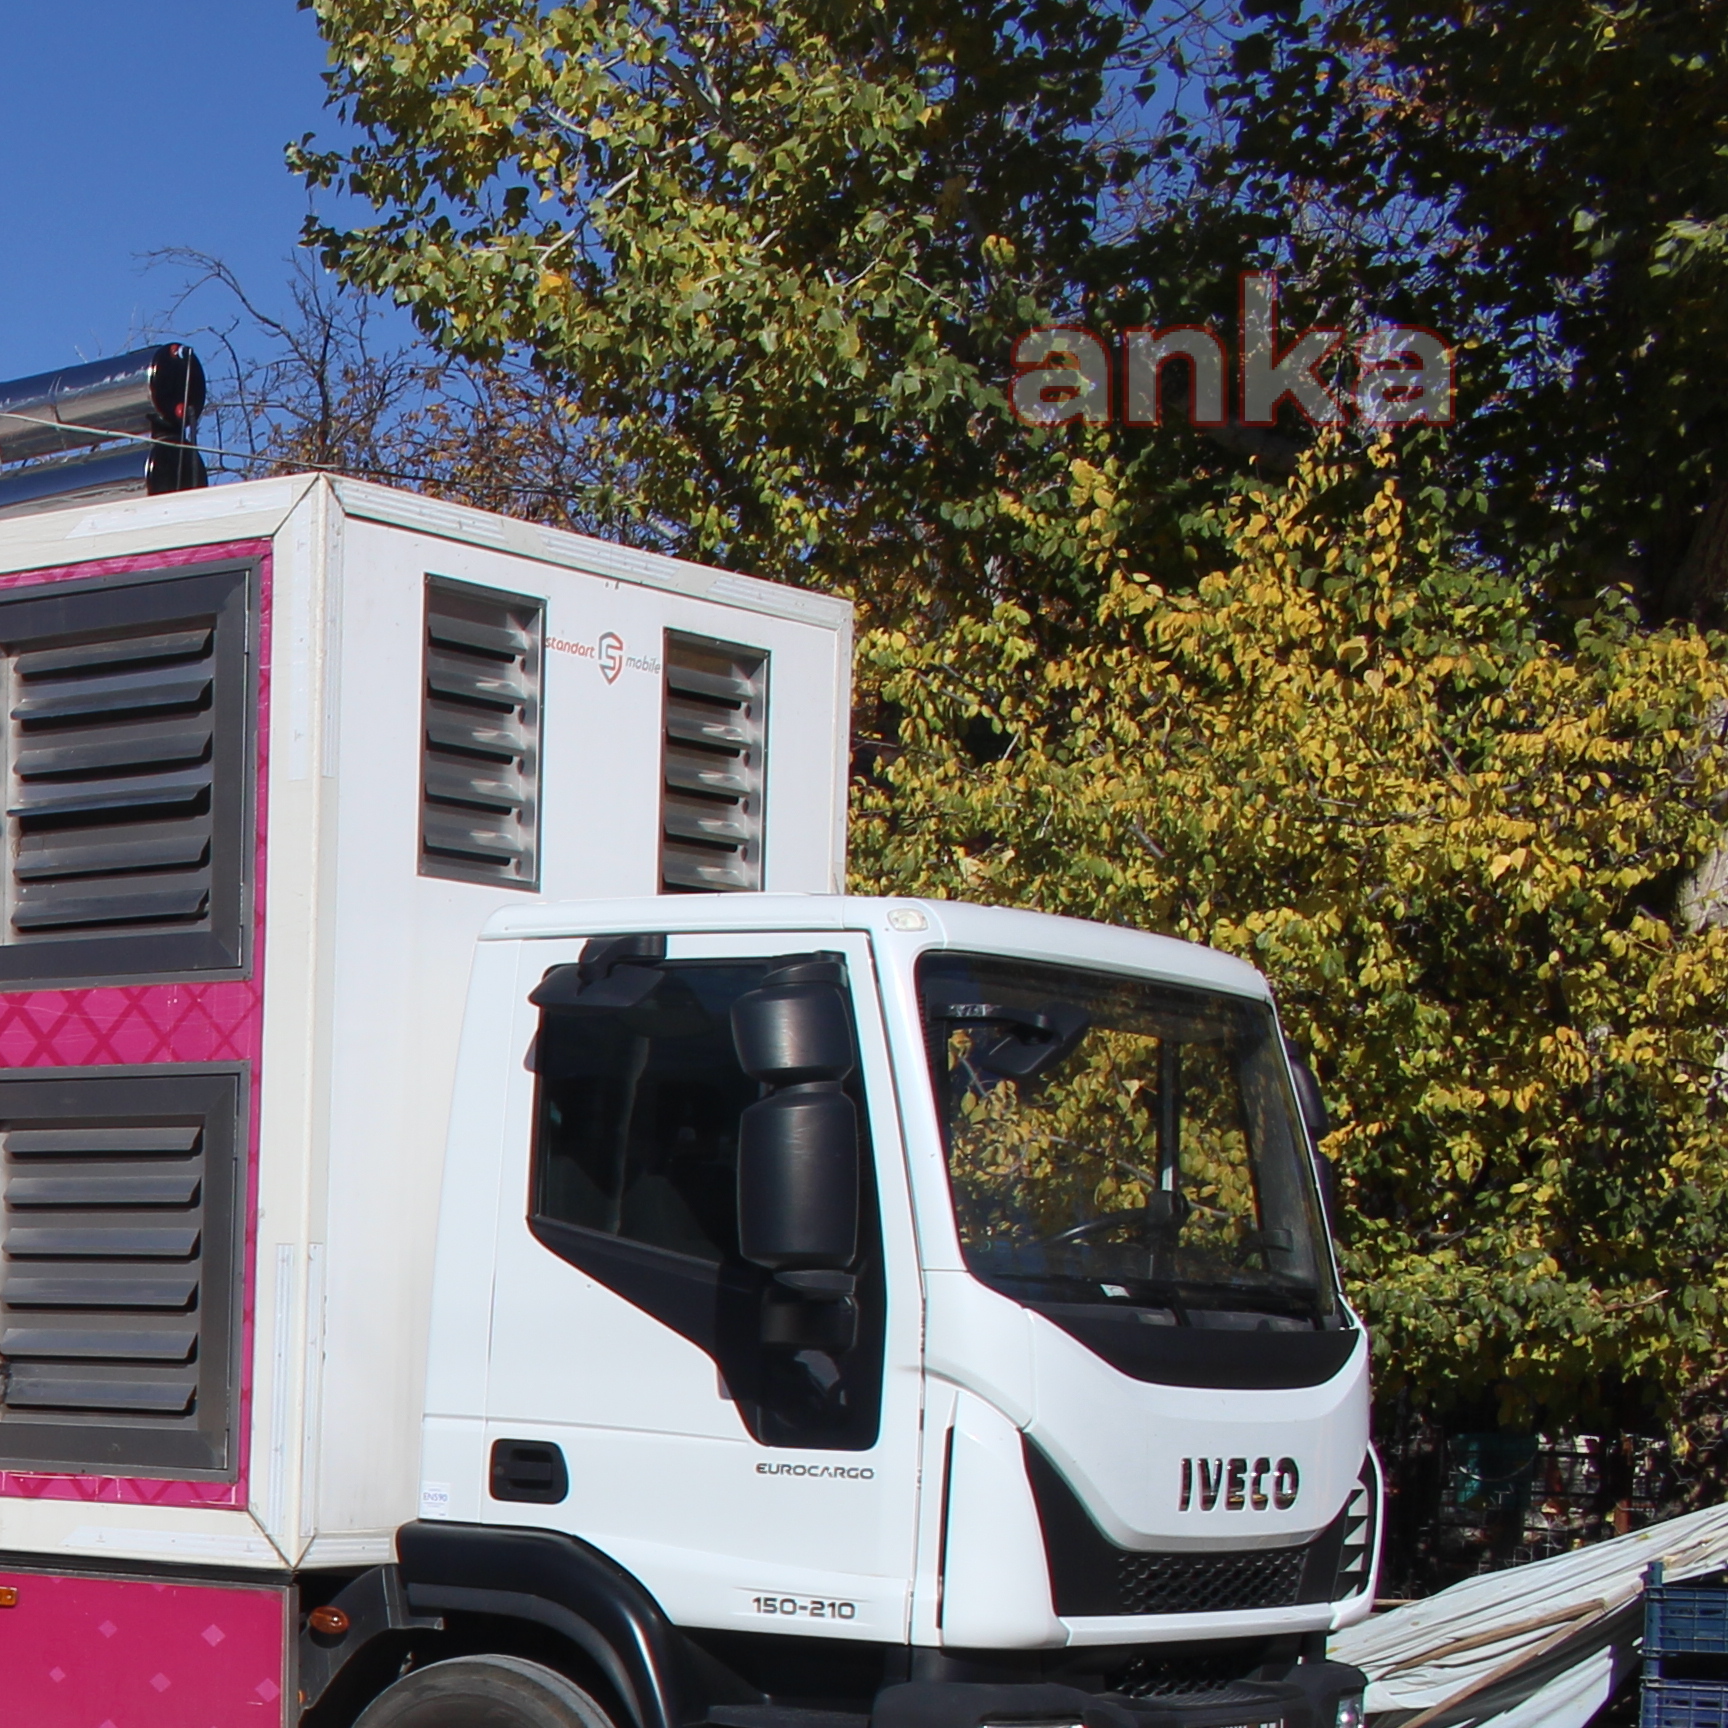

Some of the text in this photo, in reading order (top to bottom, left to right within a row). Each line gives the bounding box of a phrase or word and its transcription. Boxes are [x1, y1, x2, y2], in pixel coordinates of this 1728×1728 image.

[544, 636, 661, 675] standart mobile
[755, 1462, 875, 1480] EUROCARGO
[1177, 1456, 1300, 1512] IVECO
[751, 1596, 856, 1620] 150-210
